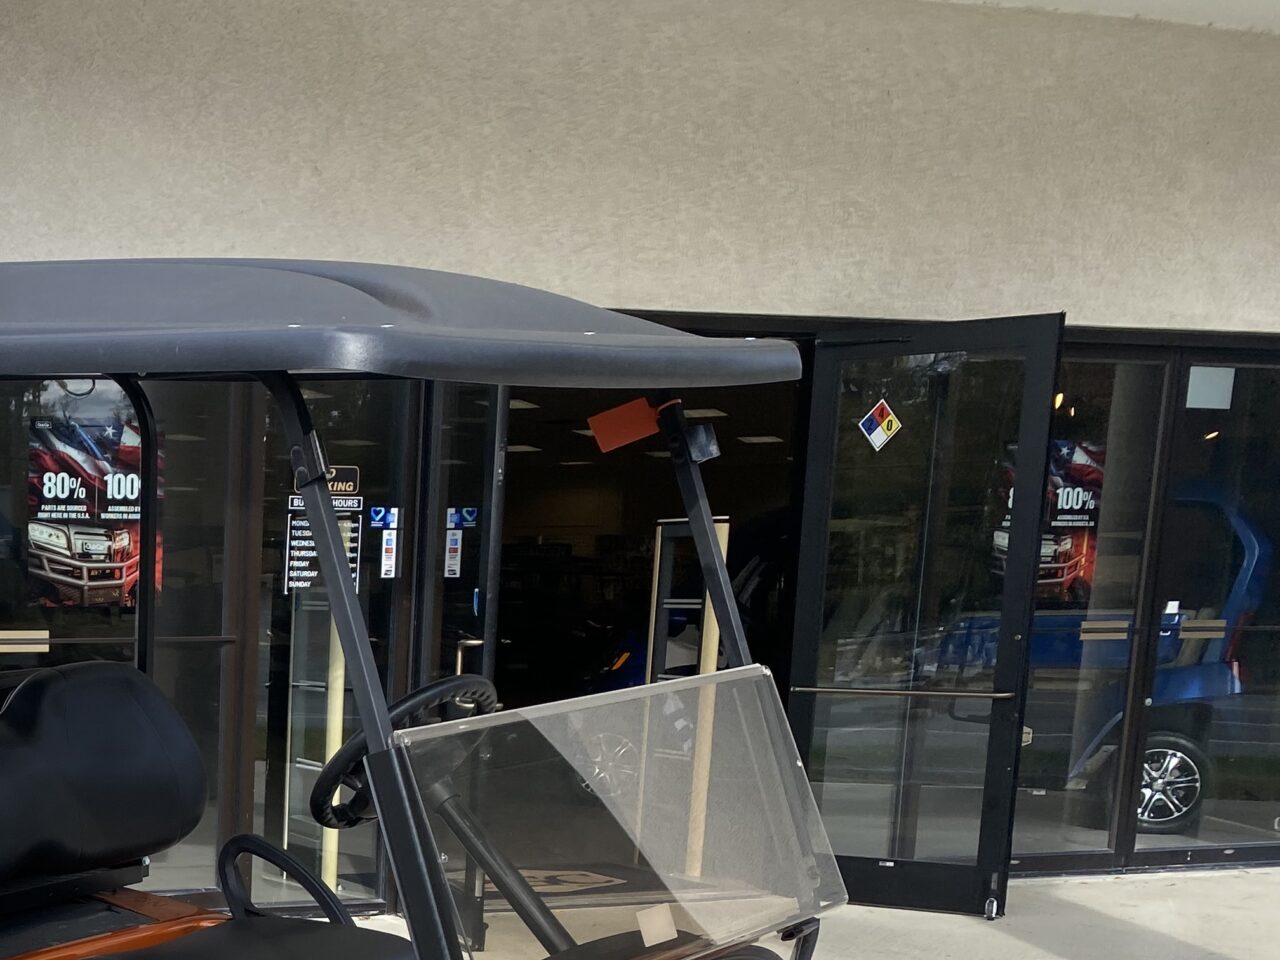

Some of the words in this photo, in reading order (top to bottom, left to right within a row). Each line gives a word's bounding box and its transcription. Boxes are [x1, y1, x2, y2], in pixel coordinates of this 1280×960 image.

[886, 419, 893, 432] 0
[42, 471, 86, 499] 80%
[103, 473, 141, 500] 100
[328, 481, 354, 491] KING
[332, 499, 359, 508] HOURS
[1056, 486, 1095, 511] 100%
